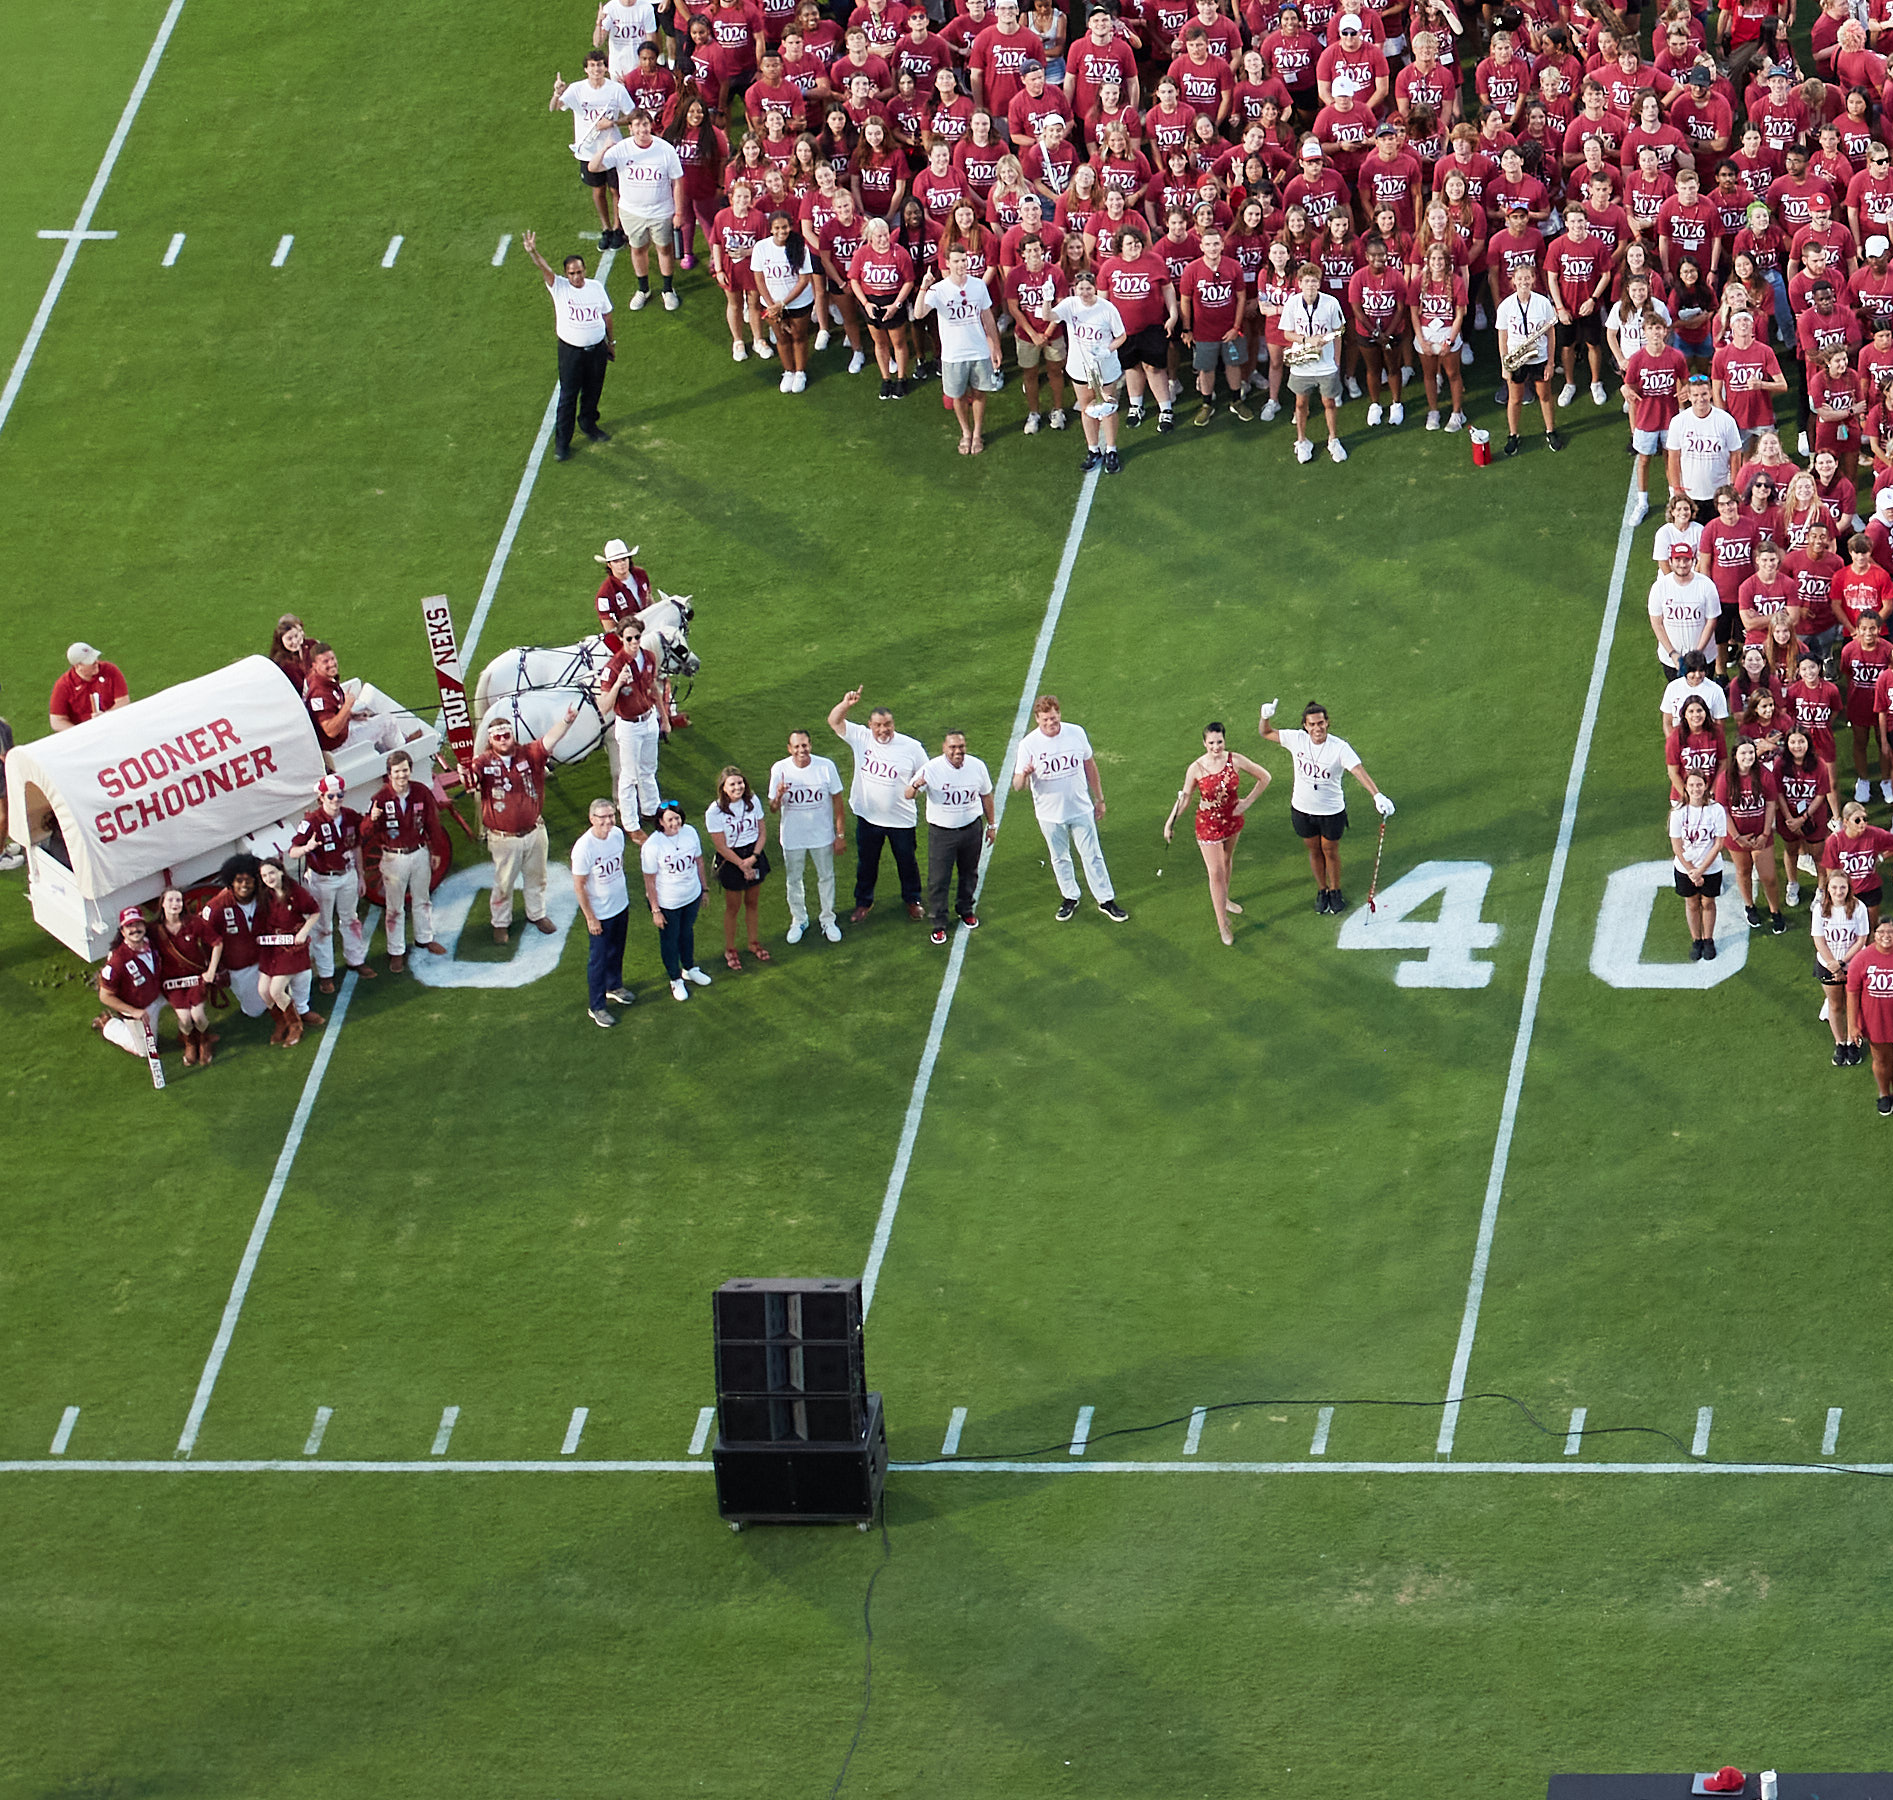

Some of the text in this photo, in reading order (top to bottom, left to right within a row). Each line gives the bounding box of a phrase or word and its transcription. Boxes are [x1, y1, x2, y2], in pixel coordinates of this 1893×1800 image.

[615, 24, 645, 38] 2026
[716, 27, 748, 41] 2026
[1184, 81, 1217, 97] 2026
[628, 168, 662, 181] 2026
[1376, 180, 1406, 194] 2026
[1671, 223, 1706, 238] 2026
[1564, 261, 1593, 275] 2026
[862, 268, 899, 283] 2026
[1112, 276, 1150, 292] 2026
[1201, 286, 1232, 300] 2026
[1643, 374, 1673, 388] 2026
[1688, 438, 1721, 453] 2026
[1718, 544, 1751, 558] 2026
[1668, 607, 1701, 620] 2026
[426, 608, 470, 730] RUF NEKS
[97, 717, 241, 798] SOONER
[1685, 754, 1717, 769] 2026
[862, 760, 897, 778] 2026
[94, 745, 278, 844] SCHOONER
[788, 789, 823, 803] 2026
[945, 790, 979, 804] 2026
[1825, 929, 1857, 942] 2026
[152, 1059, 163, 1087] NEKS
